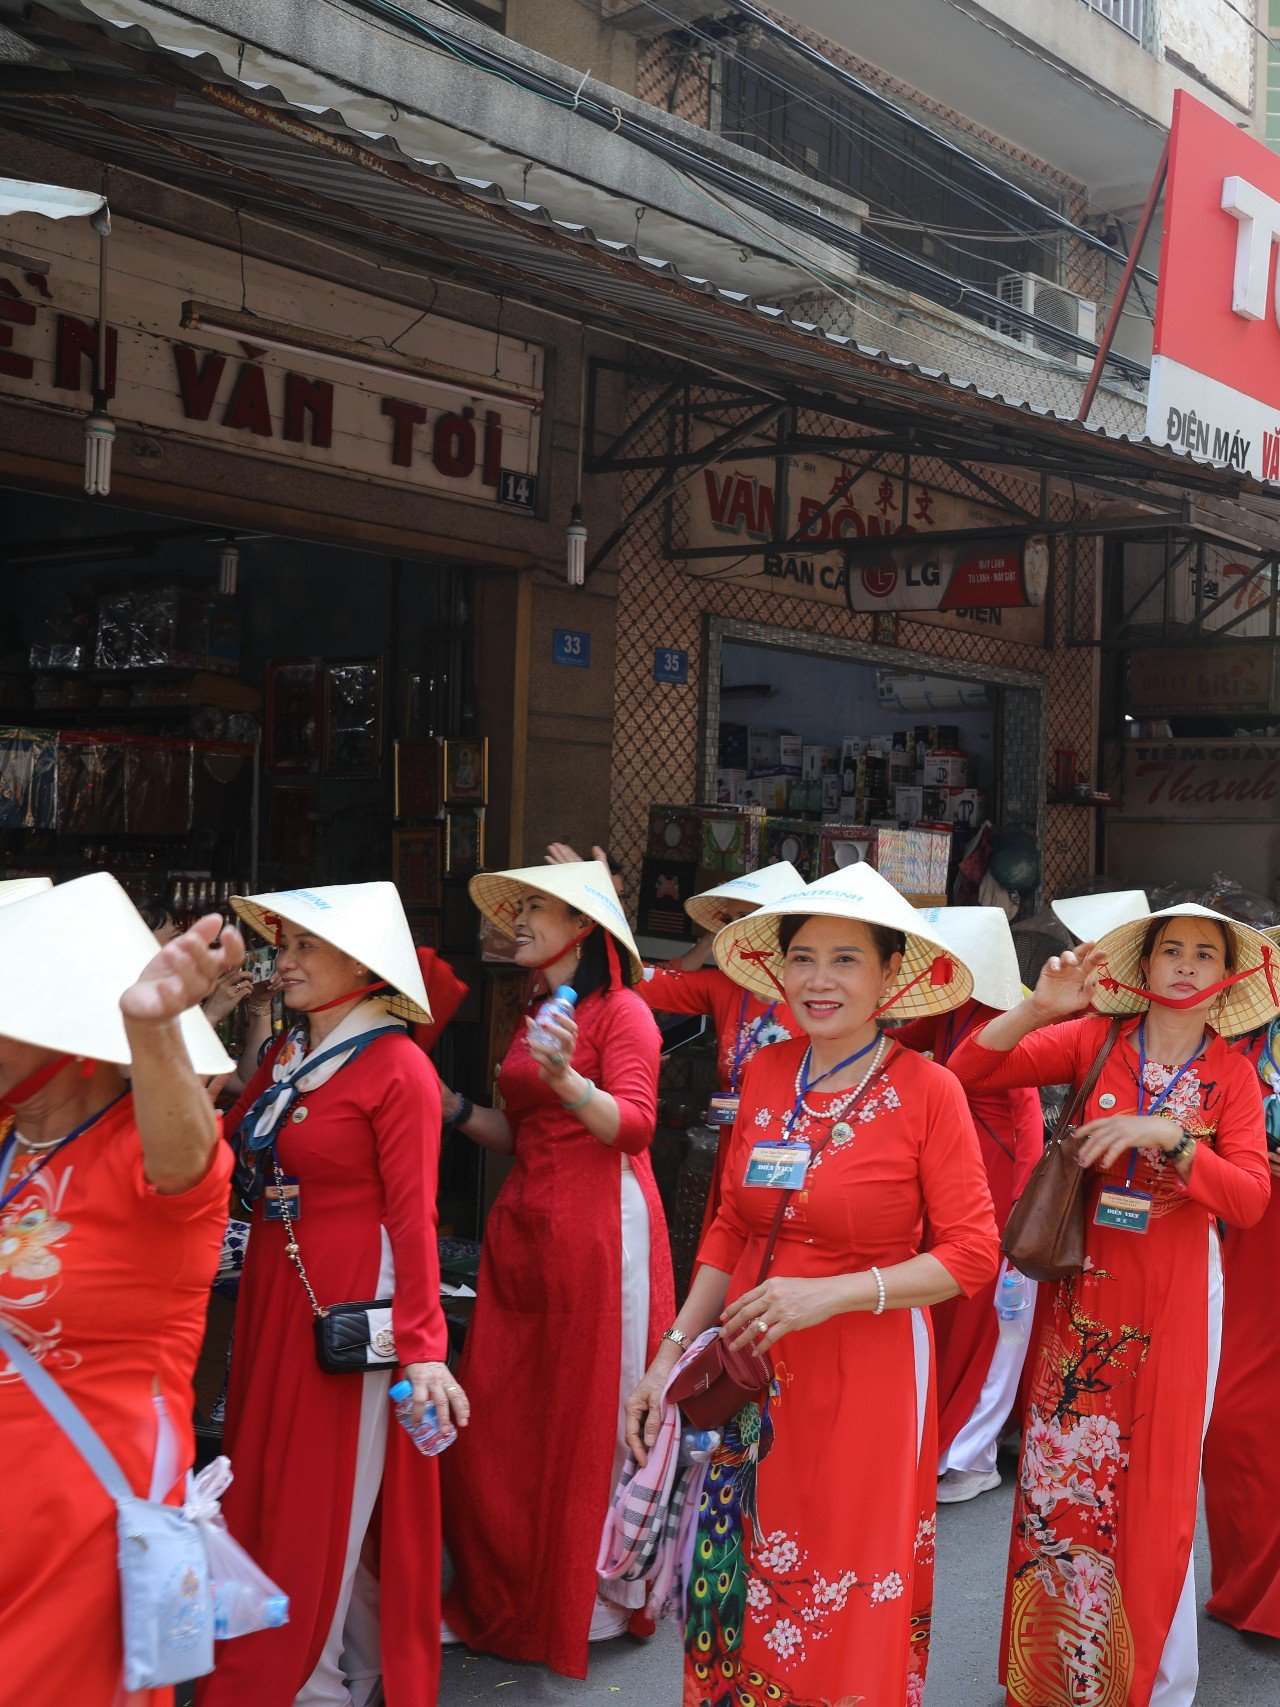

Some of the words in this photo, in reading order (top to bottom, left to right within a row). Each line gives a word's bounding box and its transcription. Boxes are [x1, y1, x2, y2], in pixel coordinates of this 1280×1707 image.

[1213, 429, 1251, 470] MÁY
[506, 474, 530, 504] 14
[906, 562, 940, 587] LG
[563, 634, 581, 655] 33
[664, 653, 680, 672] 35
[1135, 761, 1280, 804] Thanh
